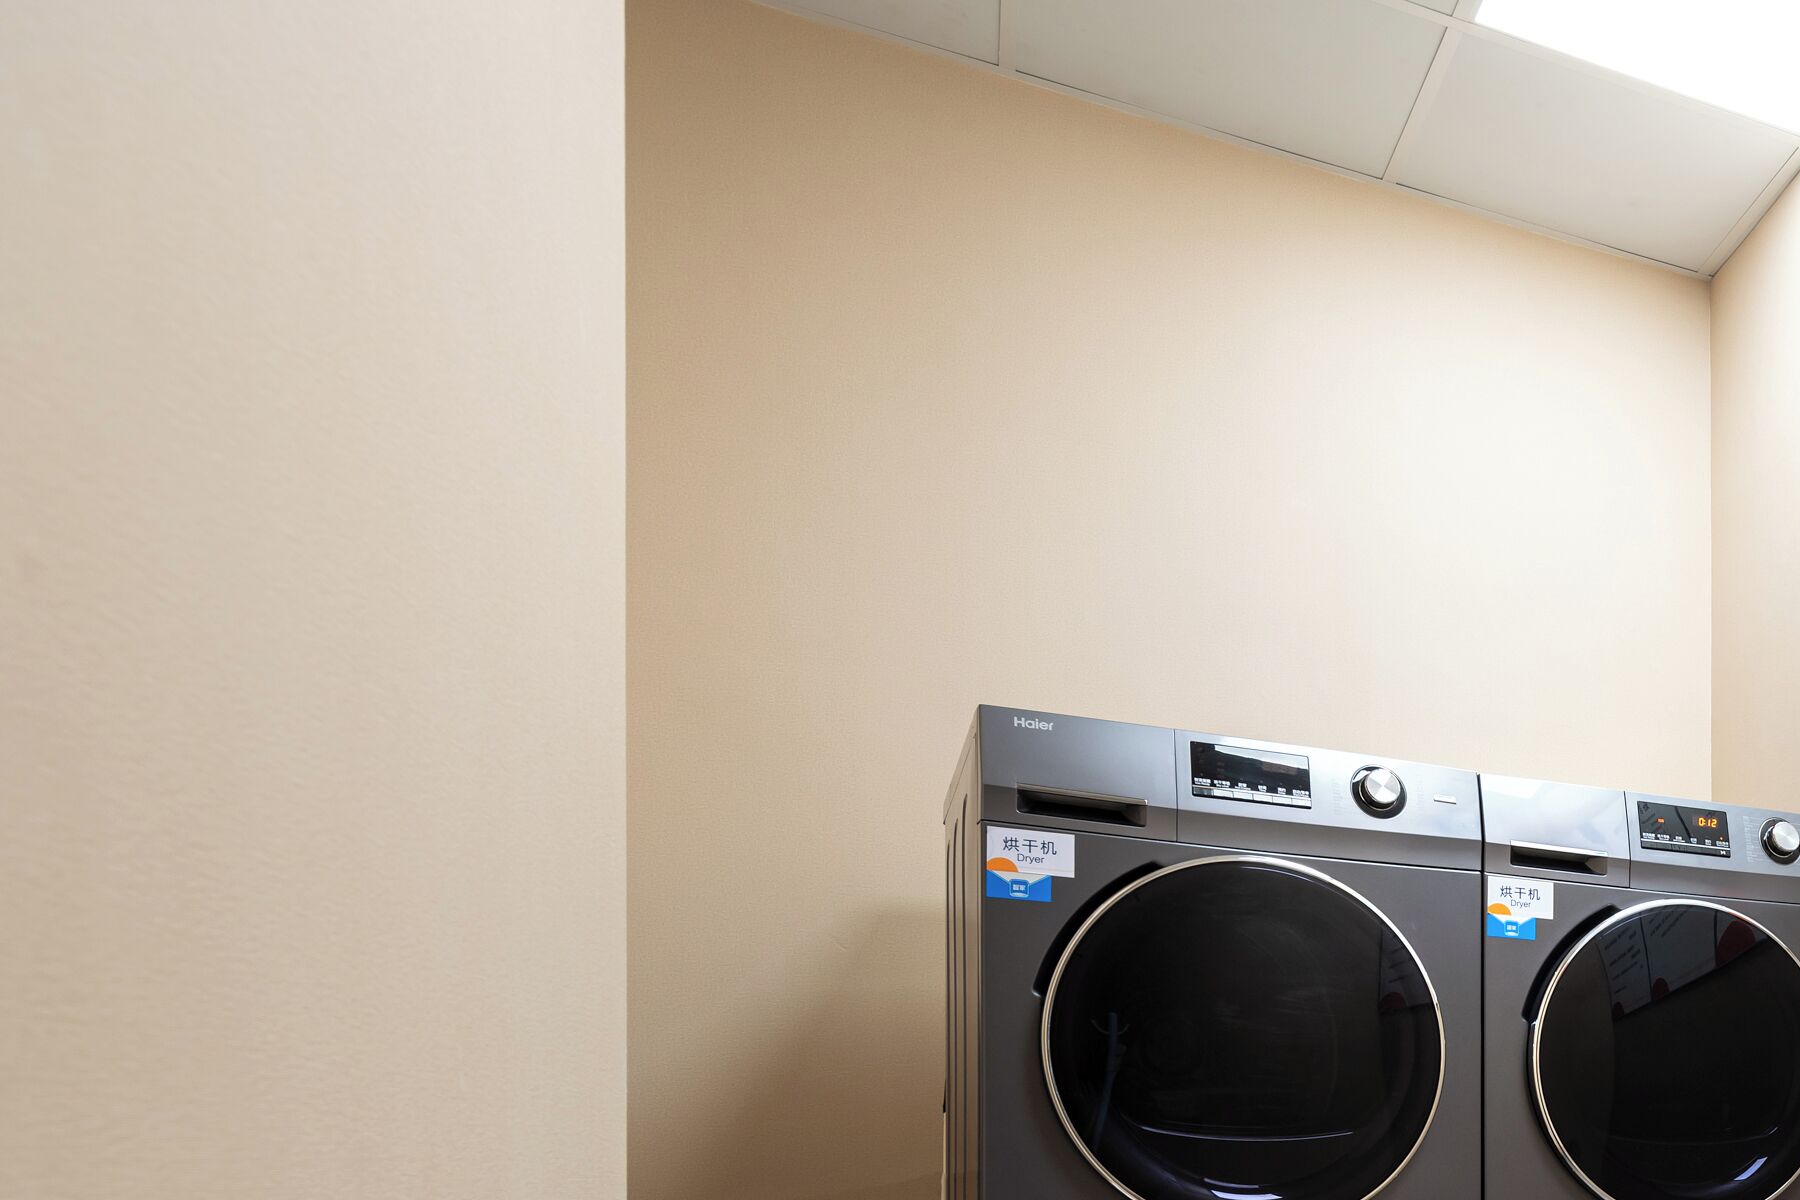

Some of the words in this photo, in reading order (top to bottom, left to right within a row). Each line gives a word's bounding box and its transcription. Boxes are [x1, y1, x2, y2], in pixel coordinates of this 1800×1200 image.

[1014, 716, 1054, 731] Haier
[1698, 817, 1717, 828] 0:12
[1003, 836, 1057, 856] 烘干机
[1017, 853, 1045, 864] Dryer
[1500, 885, 1541, 901] 烘干机
[1511, 900, 1531, 908] Dryer
